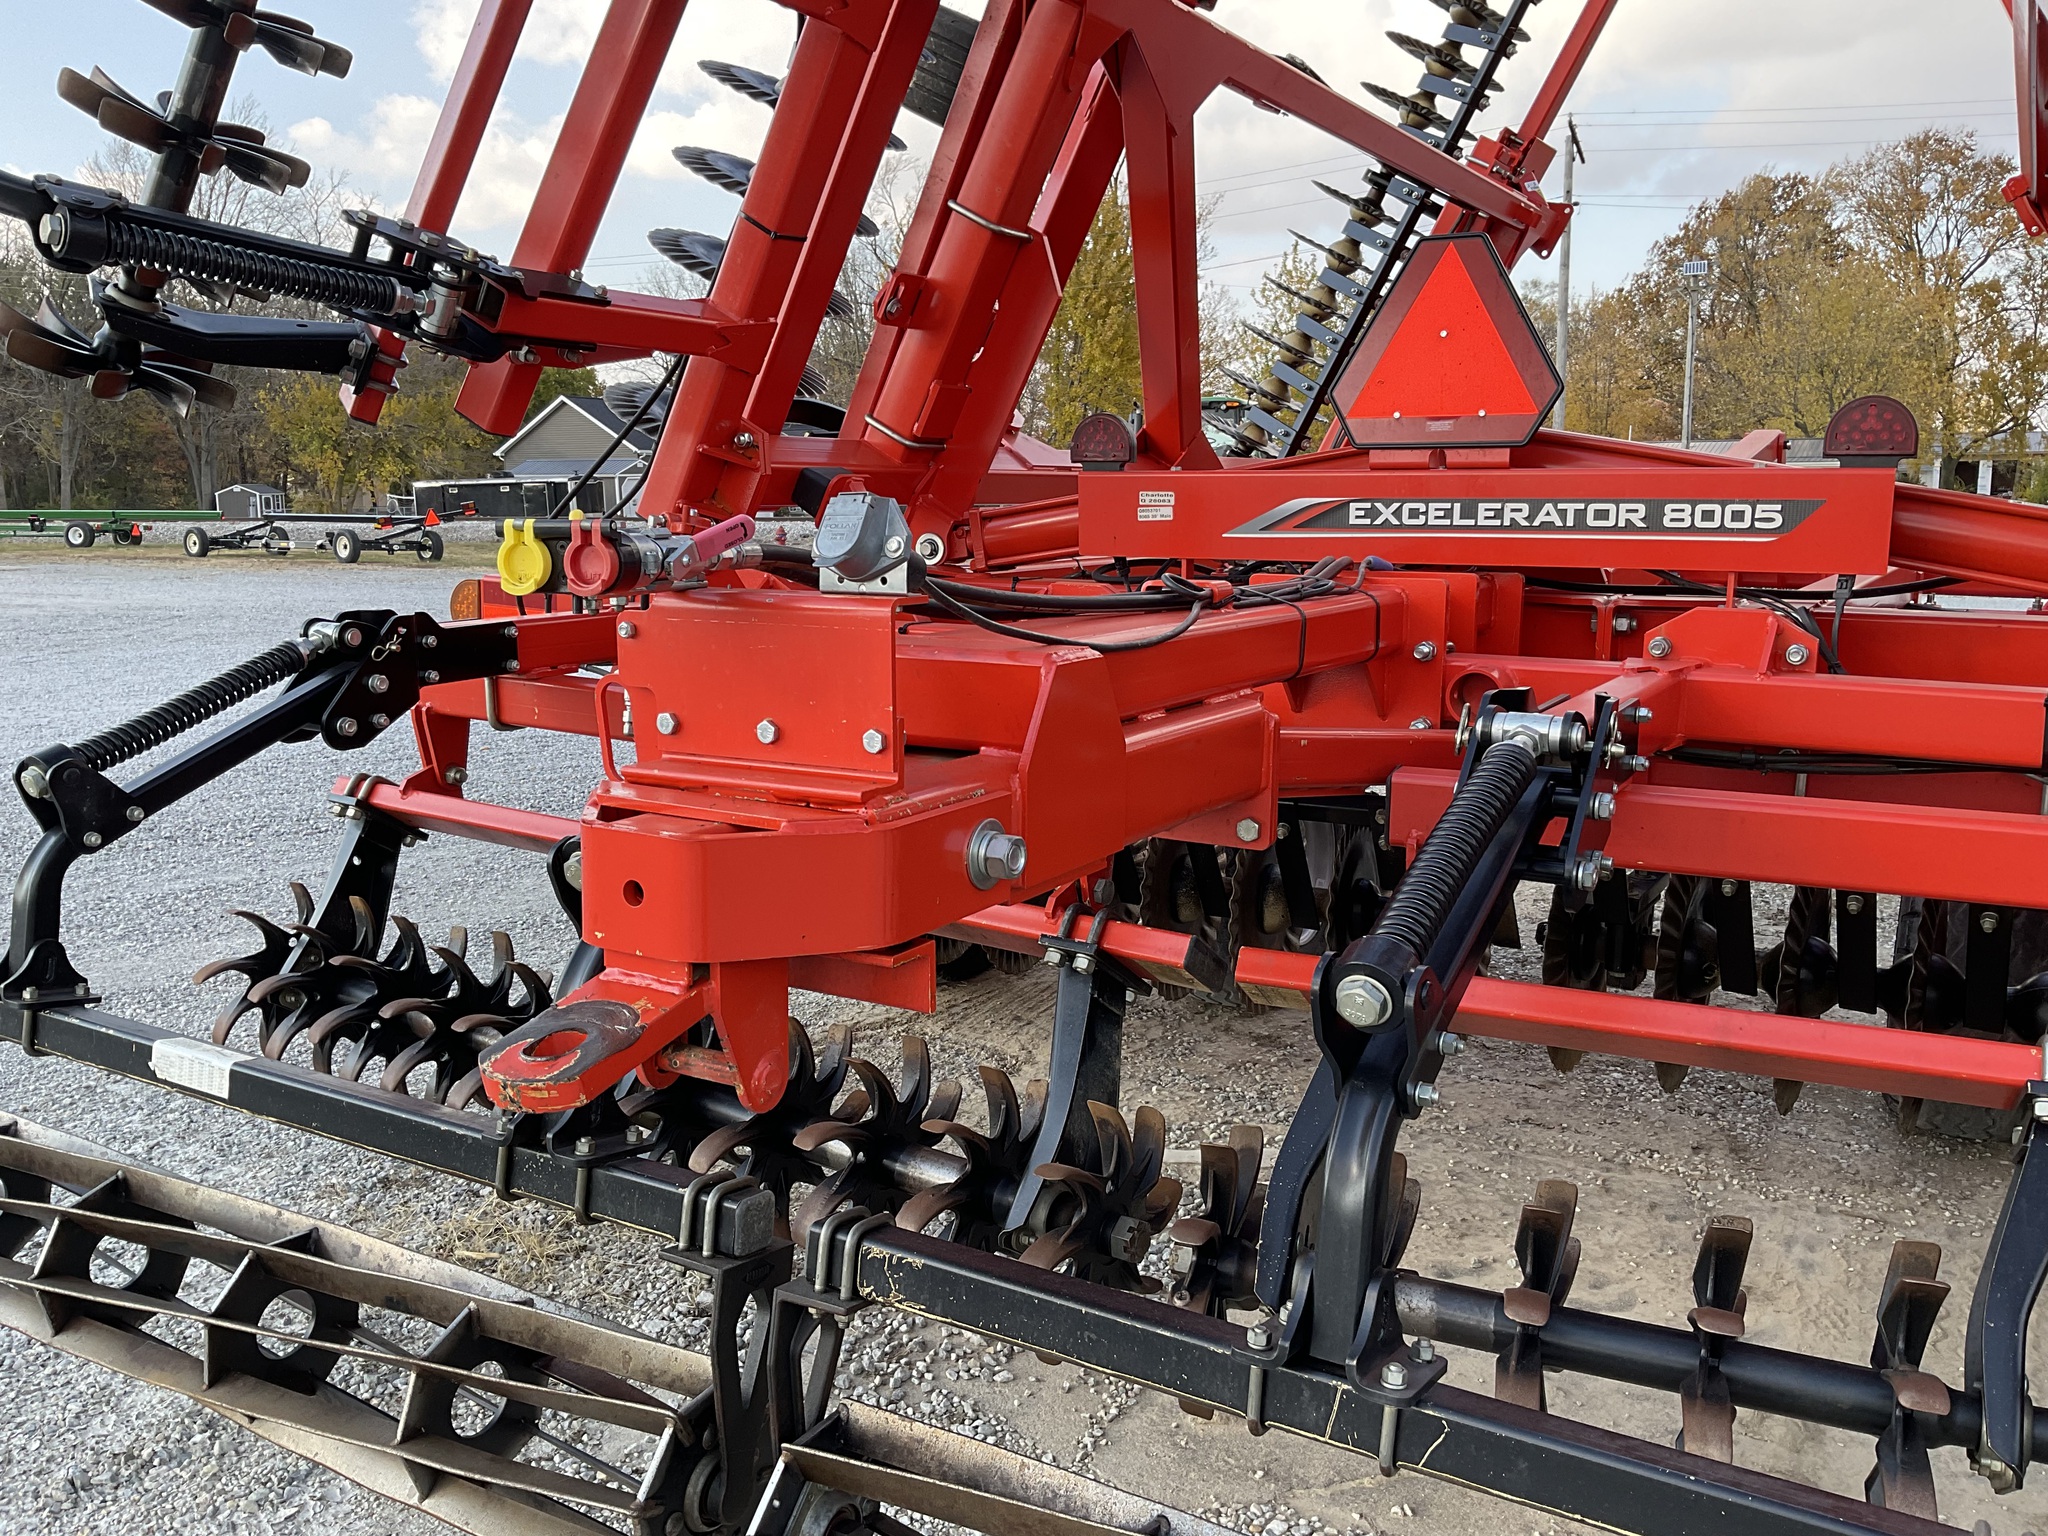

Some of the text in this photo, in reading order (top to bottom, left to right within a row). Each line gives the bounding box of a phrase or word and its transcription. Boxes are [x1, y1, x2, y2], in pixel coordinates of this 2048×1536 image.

[1349, 502, 1783, 529] EXCELERATOR 8005
[724, 536, 744, 549] CLOSED
